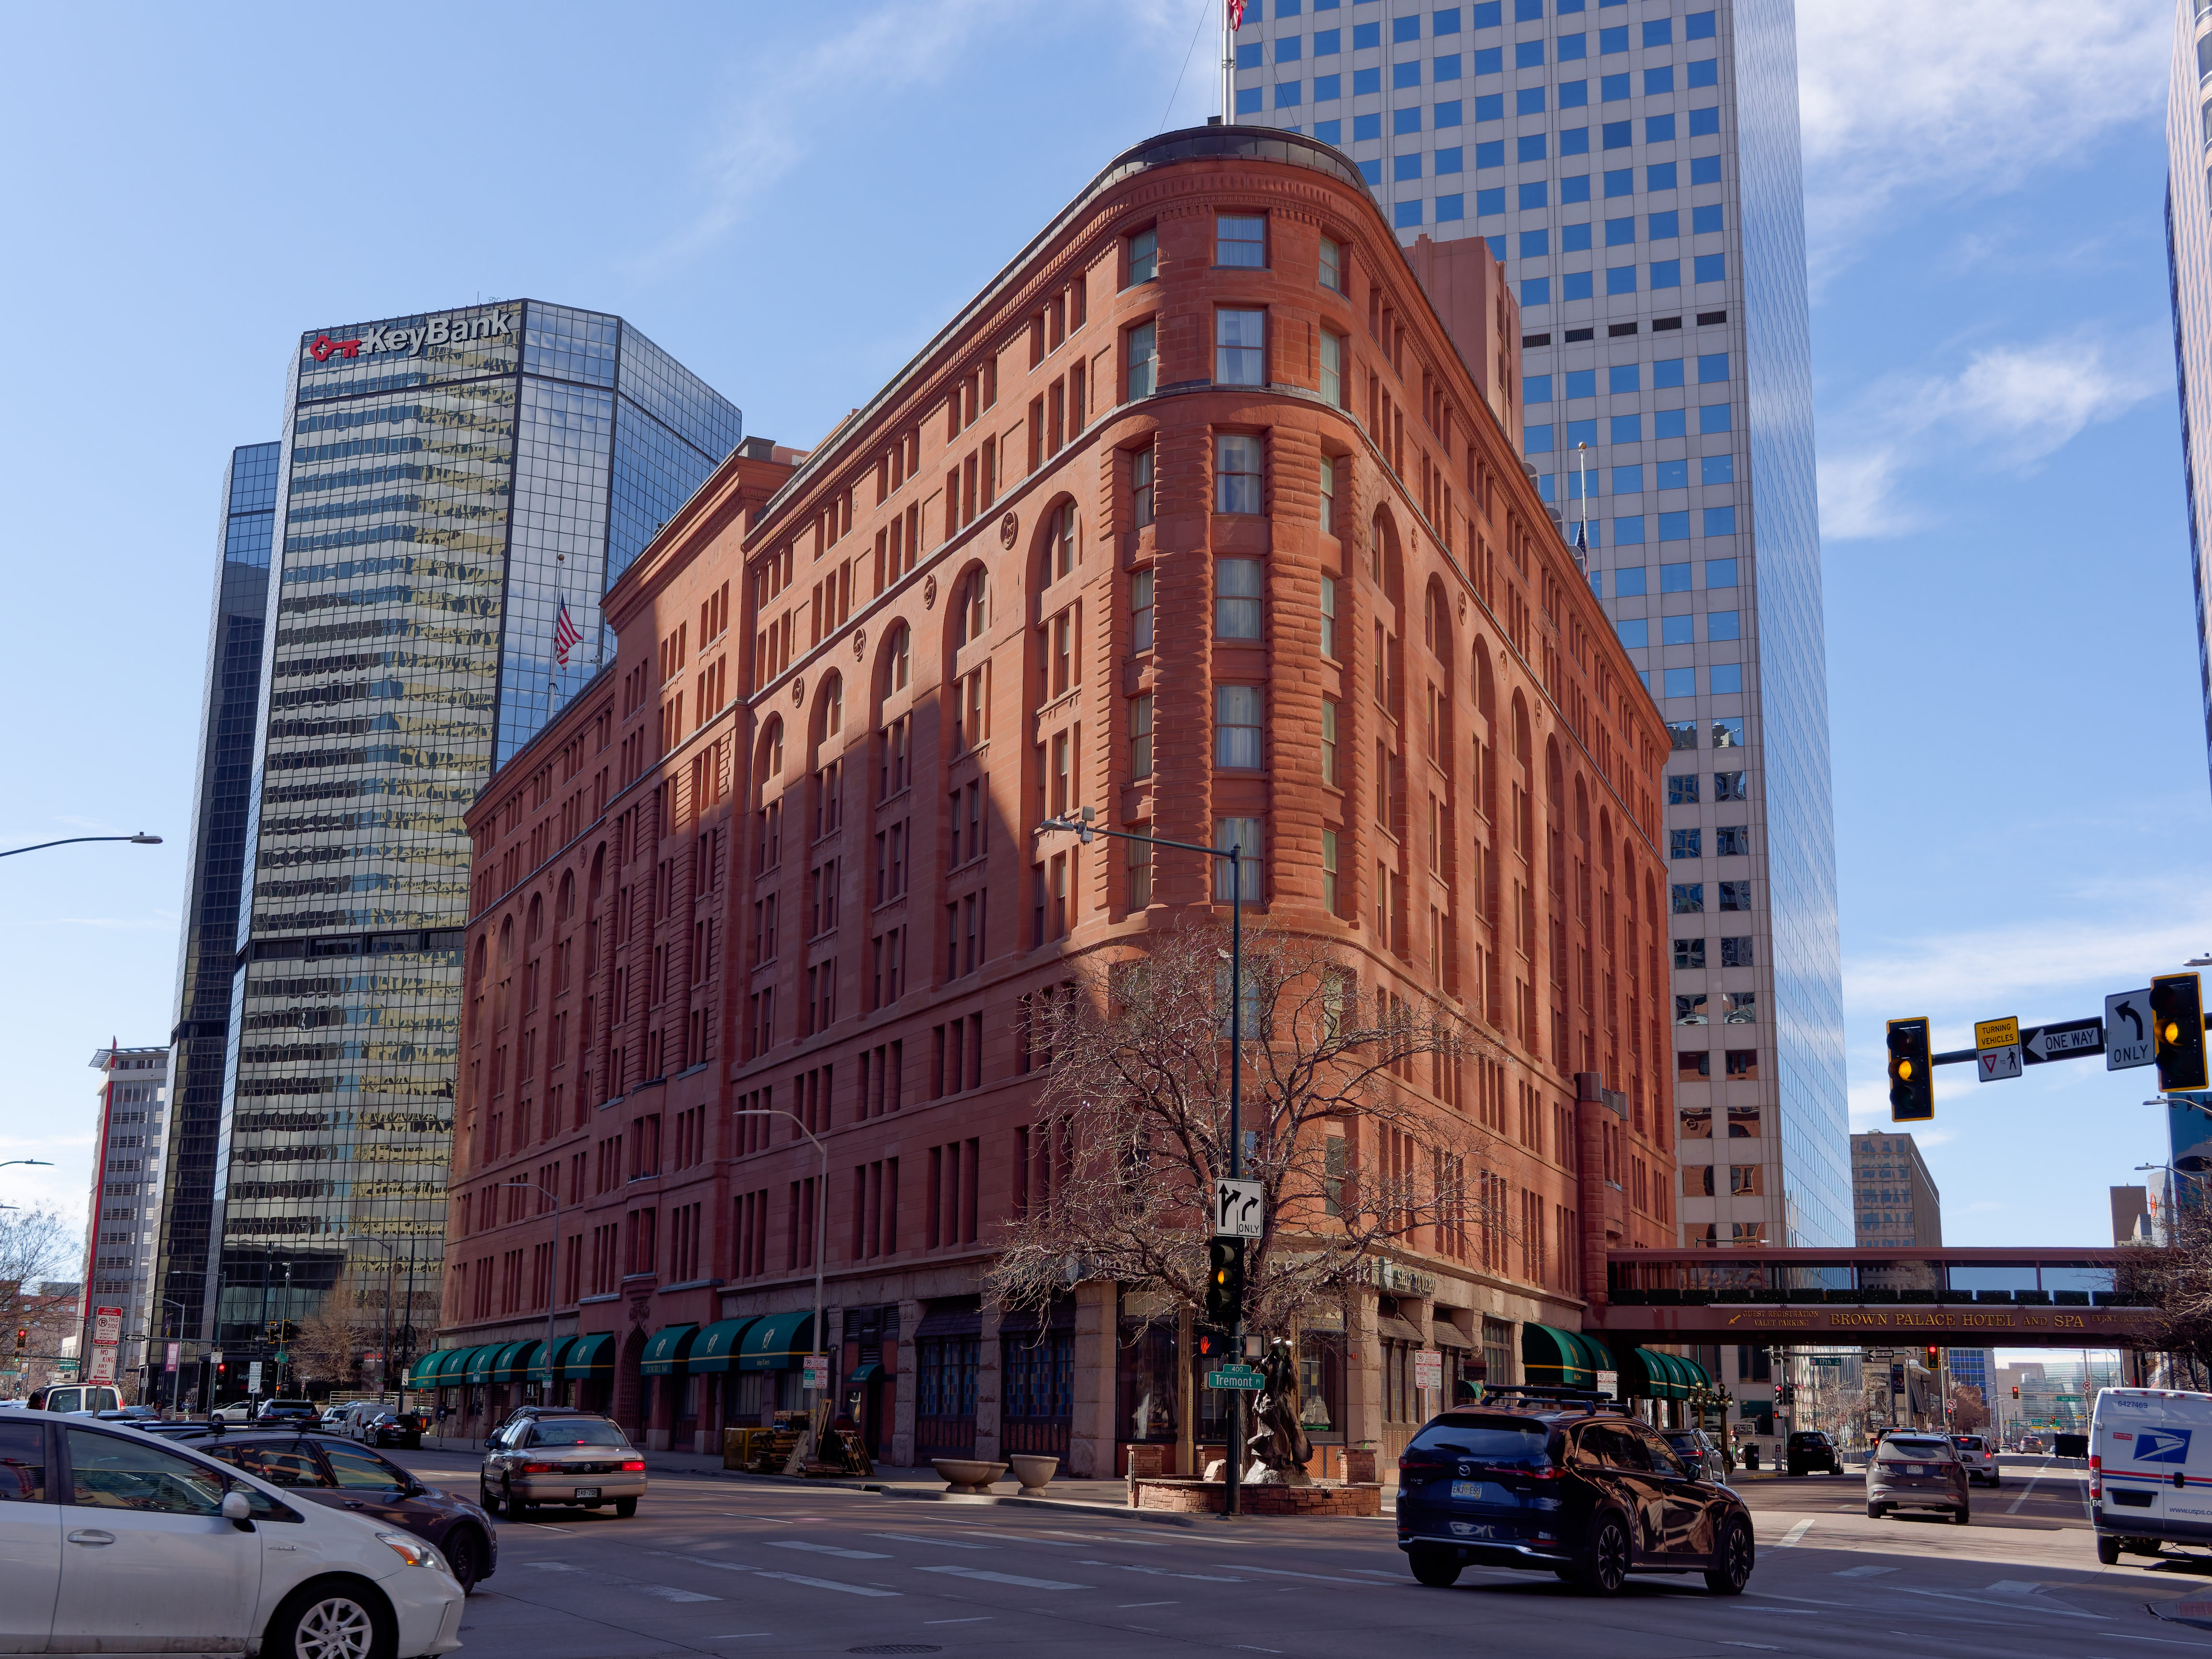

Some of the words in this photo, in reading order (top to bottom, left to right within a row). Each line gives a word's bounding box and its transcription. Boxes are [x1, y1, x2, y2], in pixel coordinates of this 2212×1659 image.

[367, 309, 512, 356] KeyBank
[1982, 1023, 2011, 1034] TURNING
[1982, 1034, 2014, 1045] VEHICLES
[2045, 1035, 2068, 1050] ONE
[2072, 1030, 2094, 1046] WAY
[2114, 1045, 2148, 1063] ONLY
[1238, 1224, 1259, 1233] ONLY
[1397, 1270, 1412, 1286] SHIP
[1415, 1274, 1436, 1294] TAVERN
[1830, 1313, 1888, 1325] BROWN
[1895, 1313, 1956, 1326] PALACE
[1962, 1314, 2016, 1326] HOTEL
[2022, 1317, 2047, 1325] AND
[2055, 1315, 2084, 1327] SPA
[1215, 1374, 1252, 1387] Tremont
